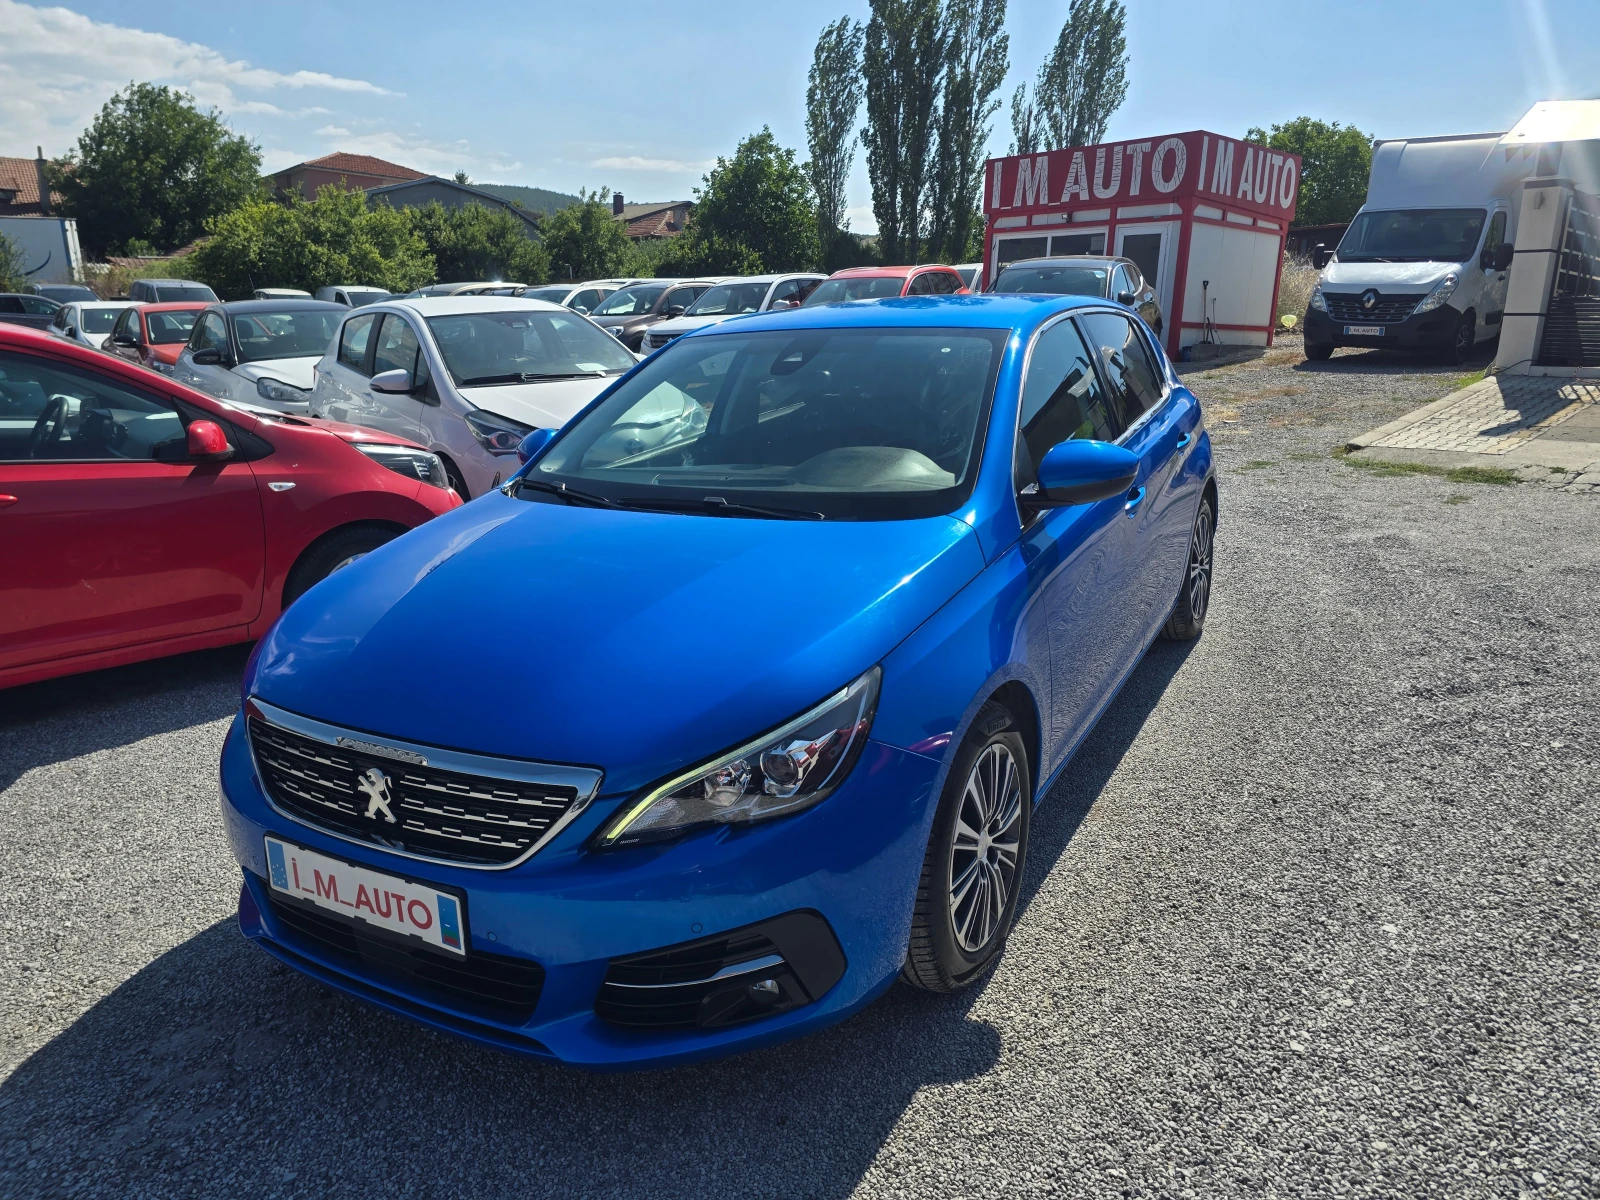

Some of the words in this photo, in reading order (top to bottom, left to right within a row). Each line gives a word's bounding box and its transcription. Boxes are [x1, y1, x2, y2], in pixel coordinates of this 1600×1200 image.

[1198, 136, 1209, 191] I
[1211, 139, 1234, 196] M
[1237, 147, 1296, 209] AUTO
